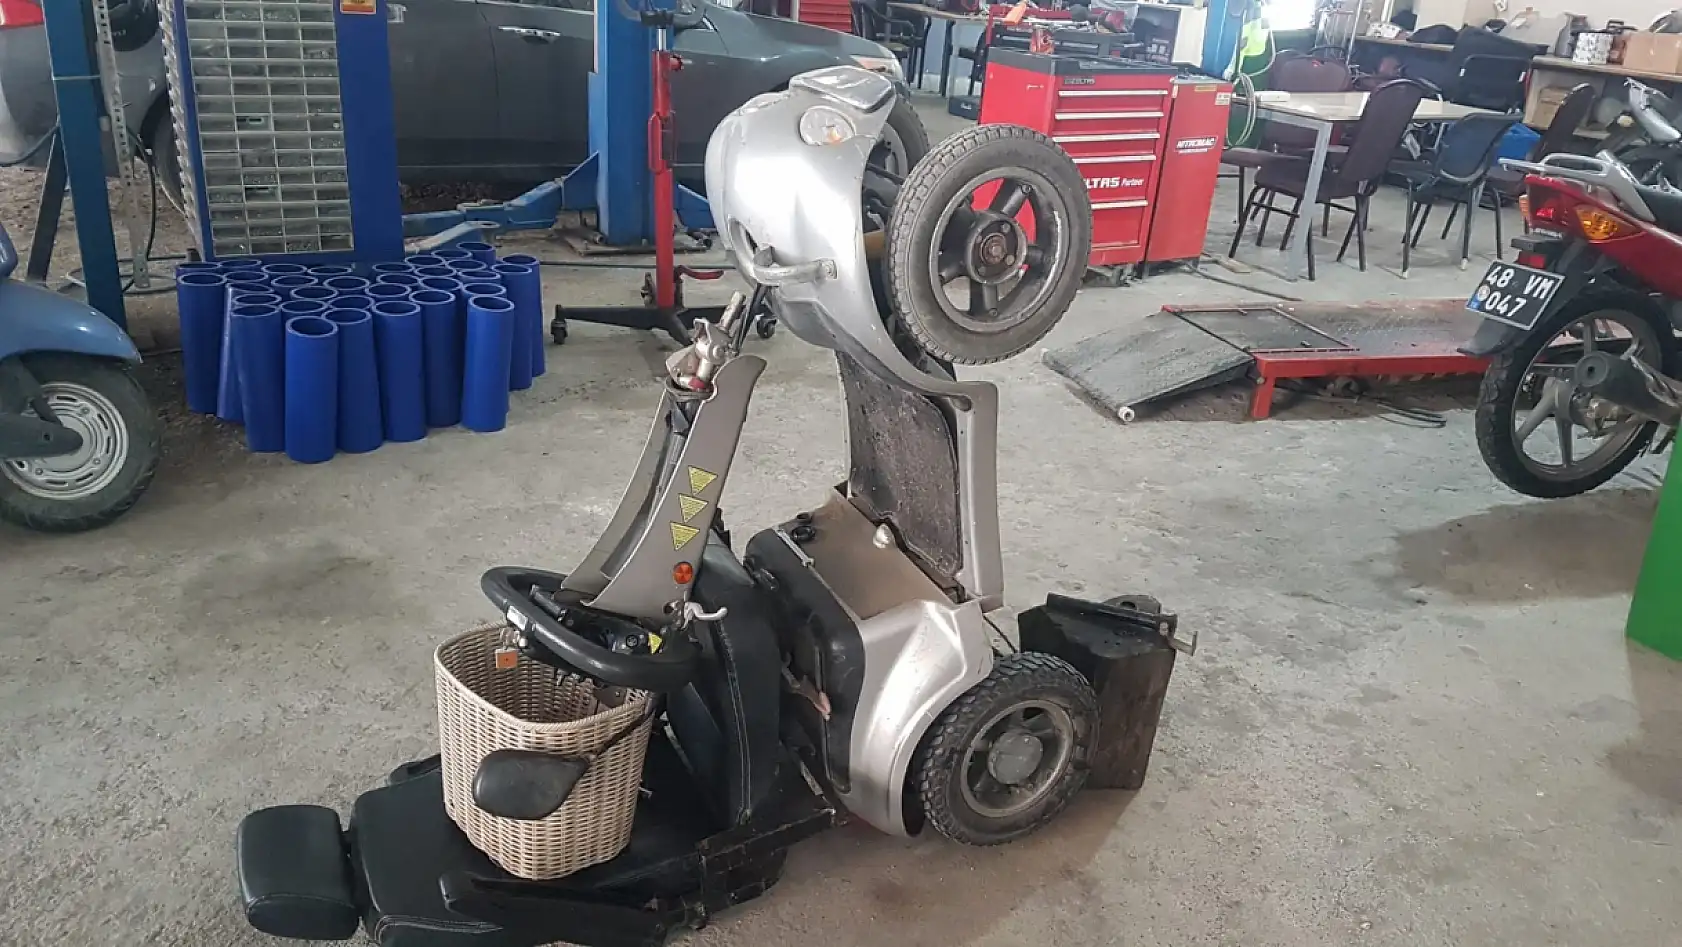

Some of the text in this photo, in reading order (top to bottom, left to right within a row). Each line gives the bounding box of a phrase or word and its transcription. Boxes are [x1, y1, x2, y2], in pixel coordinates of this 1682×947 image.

[1485, 265, 1555, 299] 48 VM
[1484, 290, 1527, 317] 047
